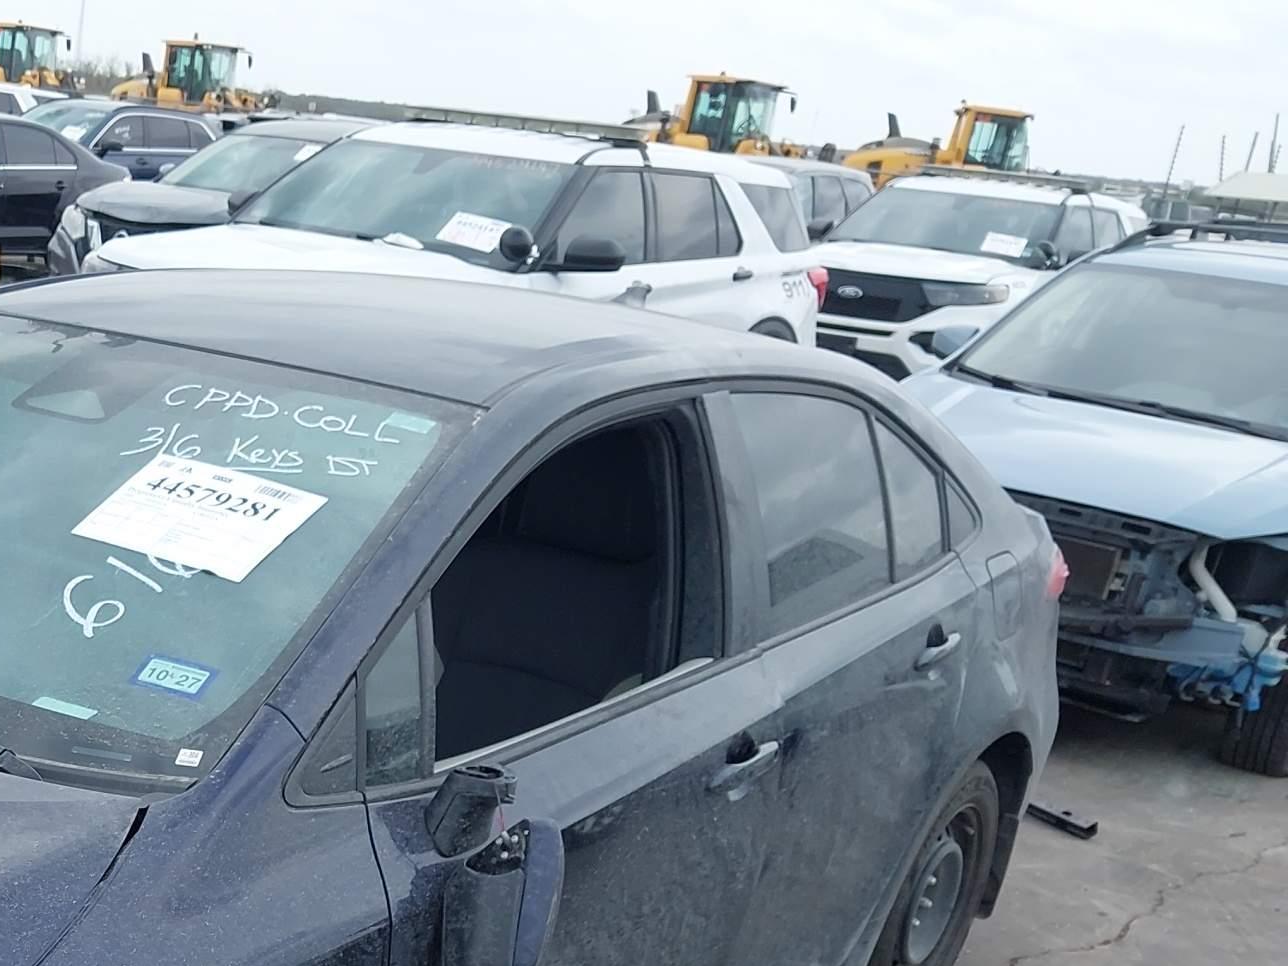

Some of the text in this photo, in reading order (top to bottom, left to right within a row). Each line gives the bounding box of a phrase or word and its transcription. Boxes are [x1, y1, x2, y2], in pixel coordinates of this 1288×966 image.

[781, 279, 806, 298] 911
[145, 476, 282, 522] 44579281
[146, 667, 203, 689] 10 27
